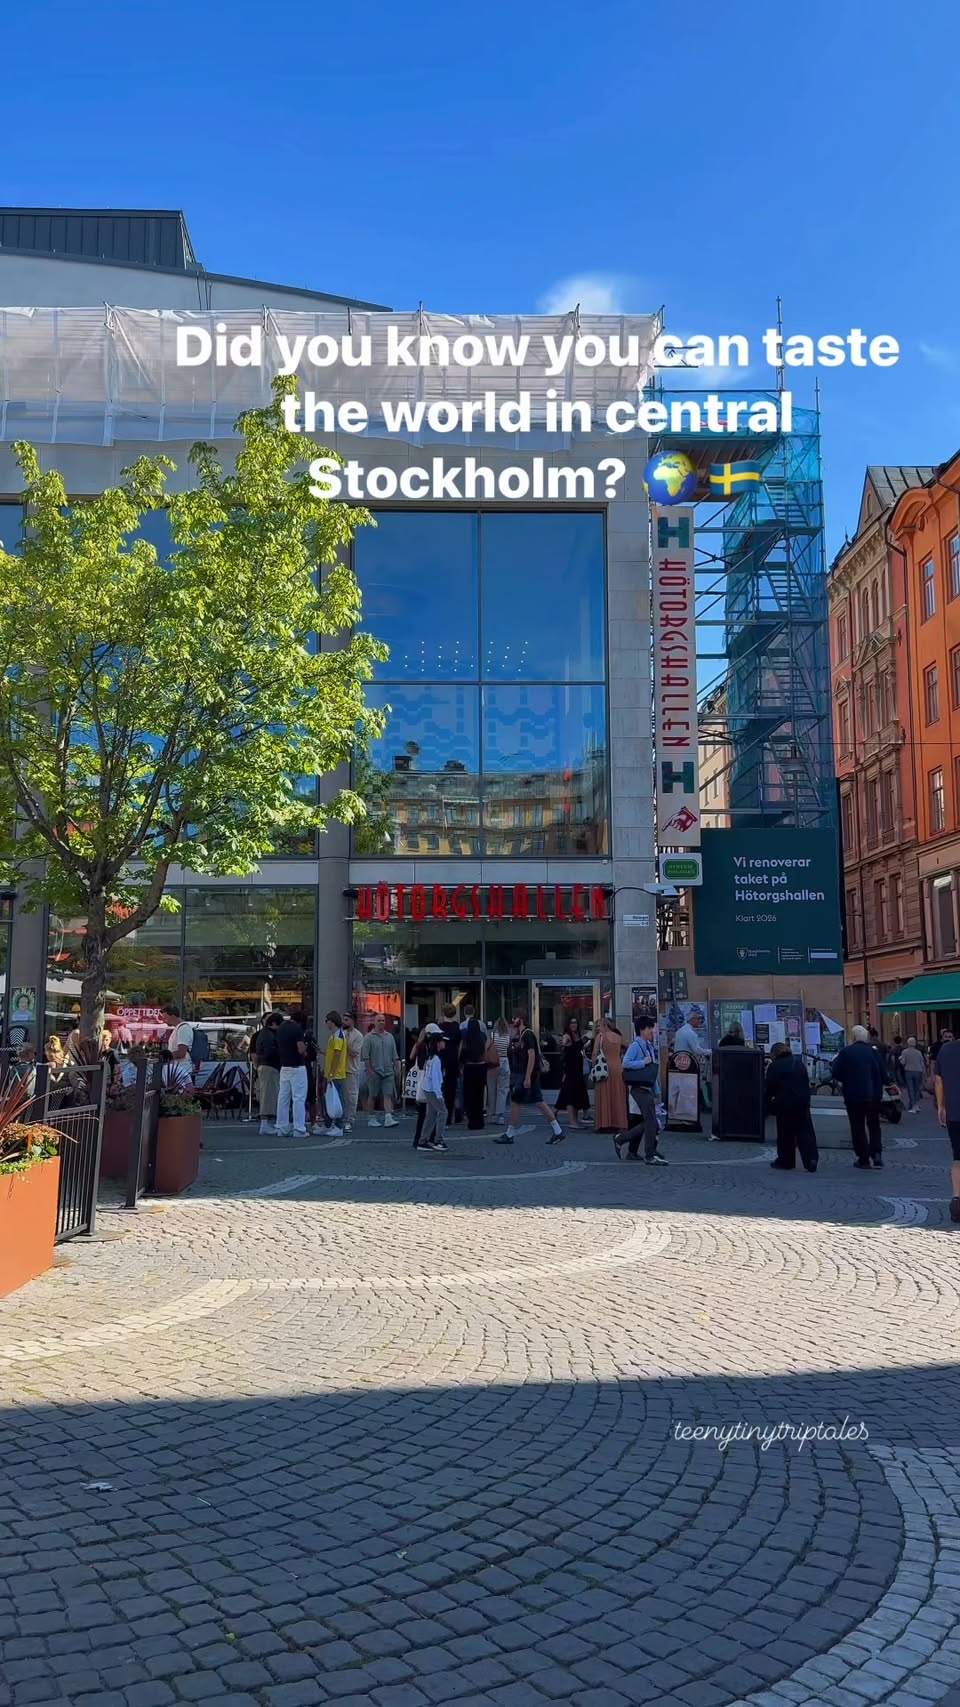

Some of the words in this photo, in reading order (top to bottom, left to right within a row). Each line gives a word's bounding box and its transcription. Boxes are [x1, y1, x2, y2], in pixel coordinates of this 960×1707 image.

[657, 516, 689, 549] H
[659, 558, 691, 747] HÖTORGSHALLEN
[661, 761, 695, 793] H
[733, 856, 746, 868] Vi
[749, 858, 812, 868] renoverar
[734, 873, 769, 884] taket
[771, 871, 788, 887] på
[356, 881, 605, 921] HÖTORGSHALLEN
[735, 889, 825, 904] Hötorgshallen
[735, 914, 755, 922] Klart
[756, 914, 777, 922] 2026
